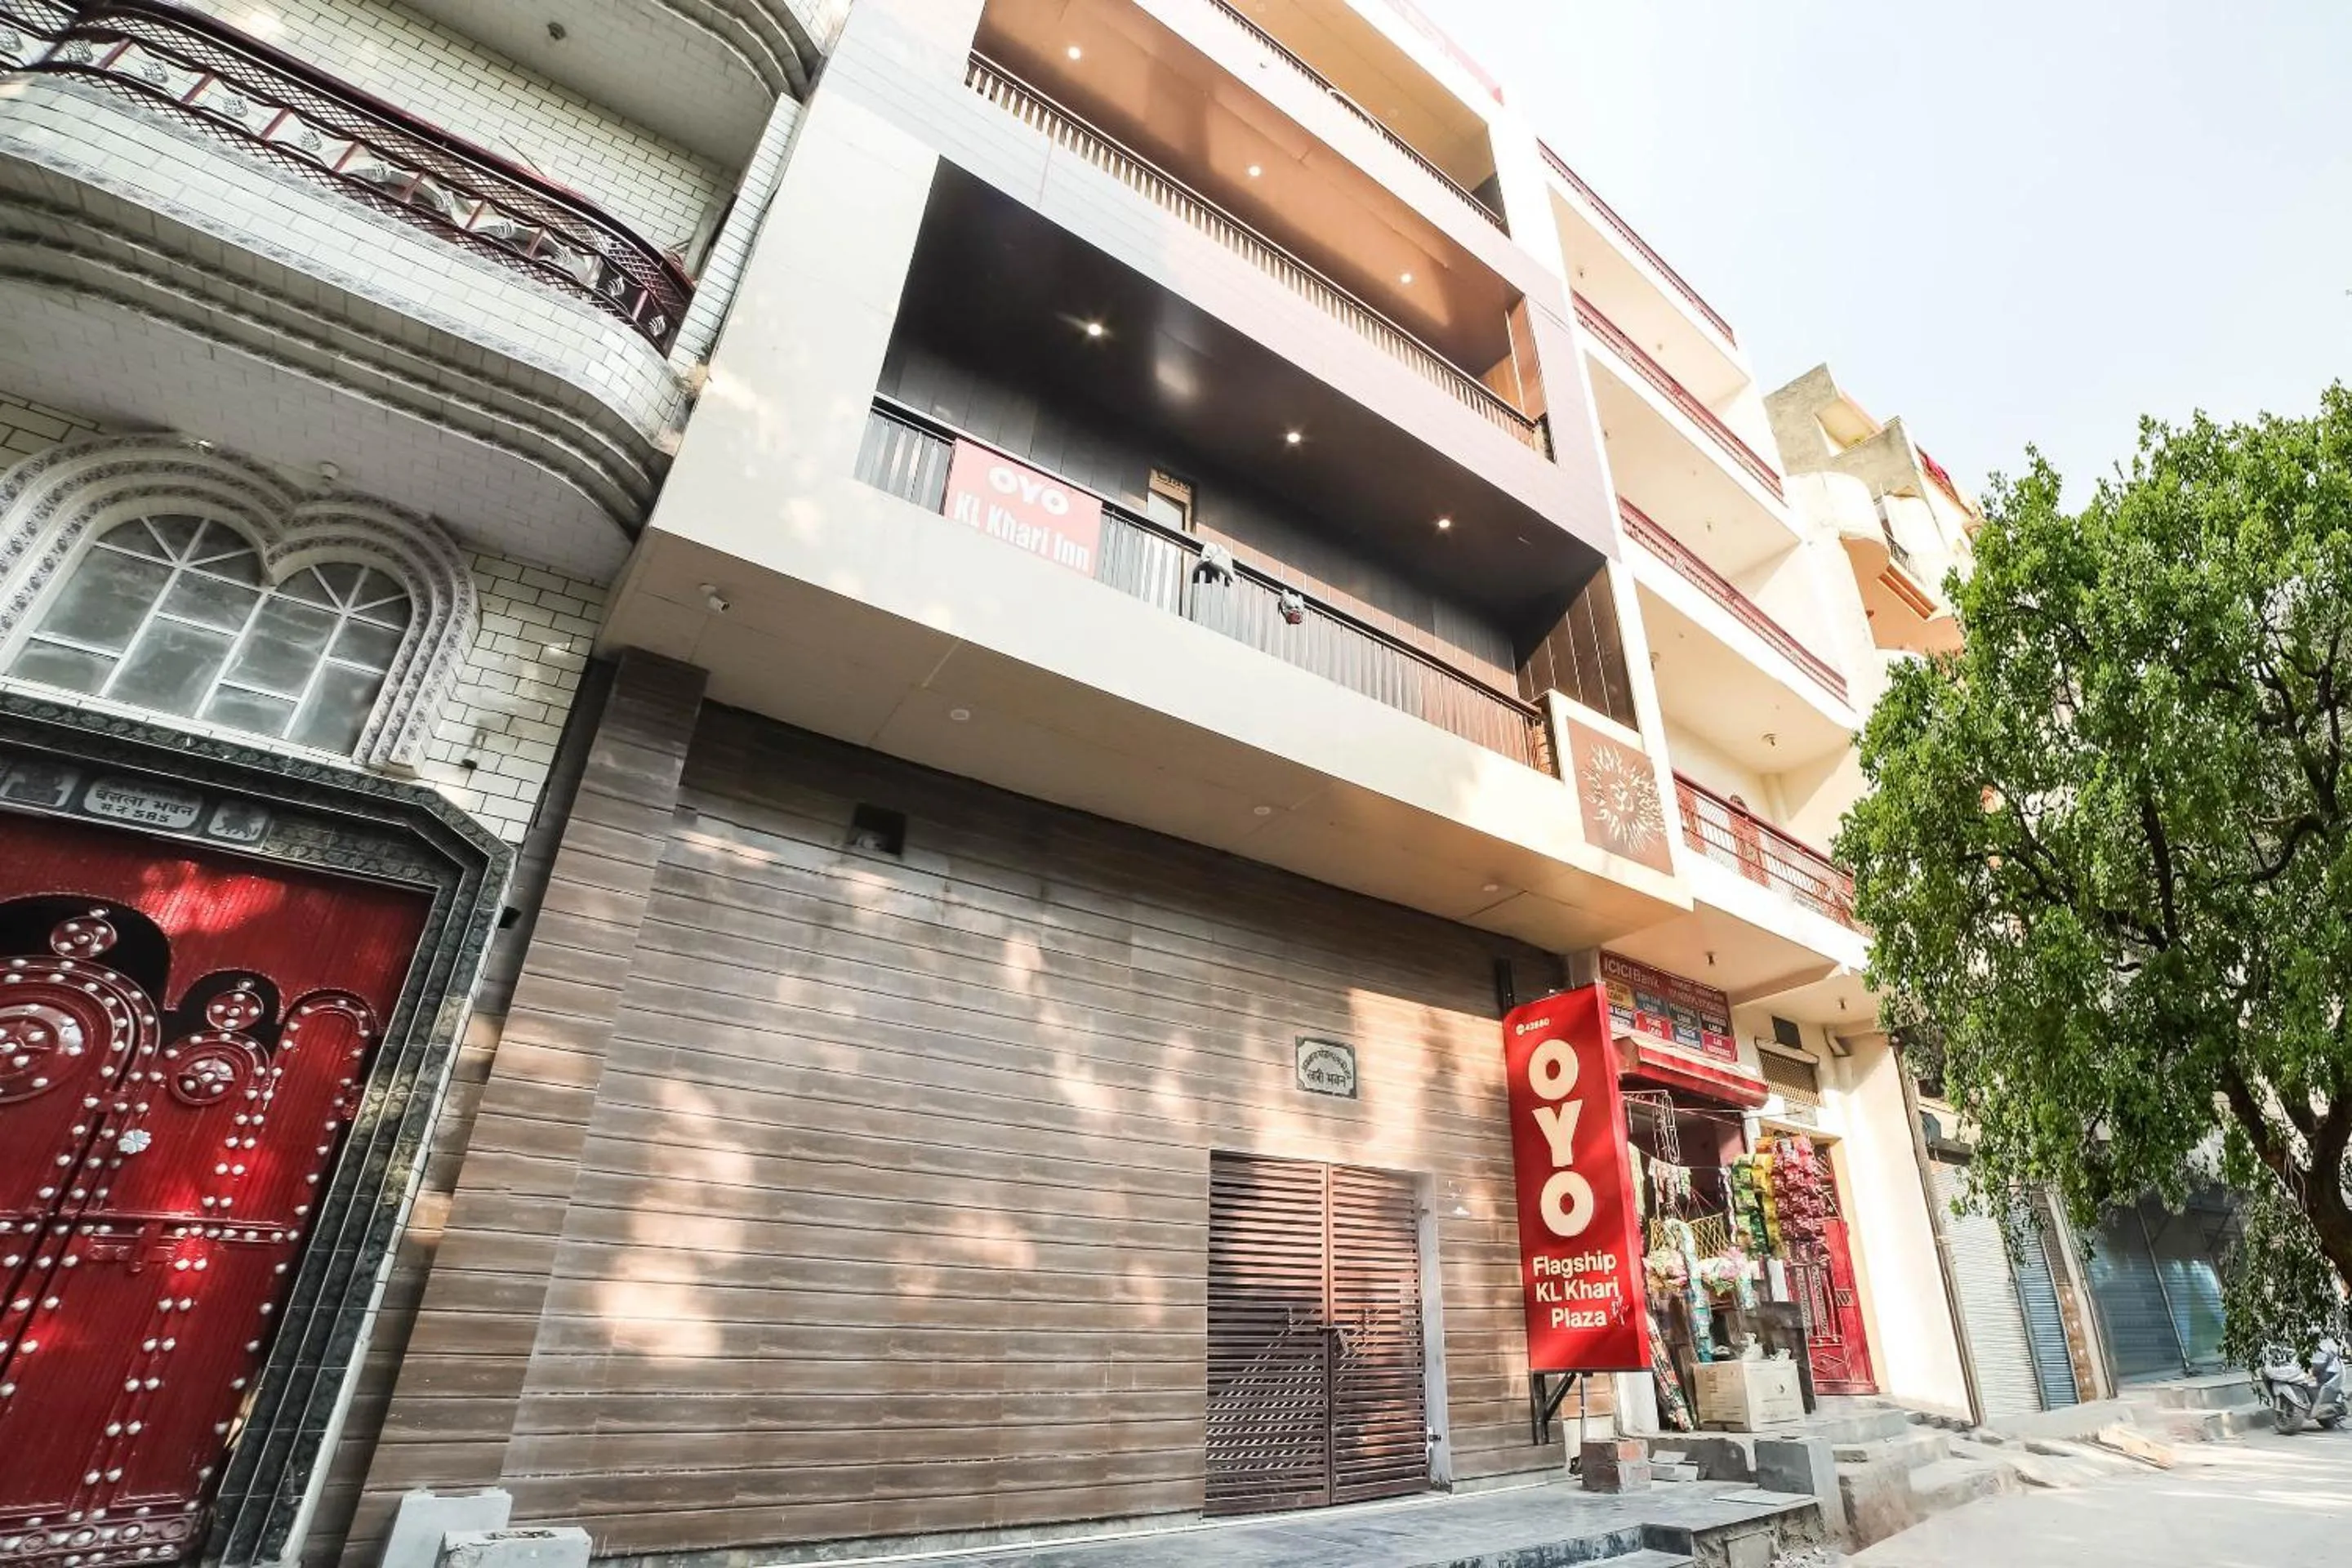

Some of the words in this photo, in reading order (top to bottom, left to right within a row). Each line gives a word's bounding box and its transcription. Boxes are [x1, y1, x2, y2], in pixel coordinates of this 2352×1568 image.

[989, 466, 1069, 515] OYO
[987, 503, 1050, 555] Khari
[1054, 532, 1089, 572] Inn
[1604, 956, 1633, 980] ICICI
[1528, 1039, 1594, 1236] OYO
[1533, 1250, 1617, 1278] Flagship
[1536, 1281, 1562, 1302] KL
[1565, 1276, 1619, 1300] Khari
[1552, 1307, 1607, 1329] Plaza
